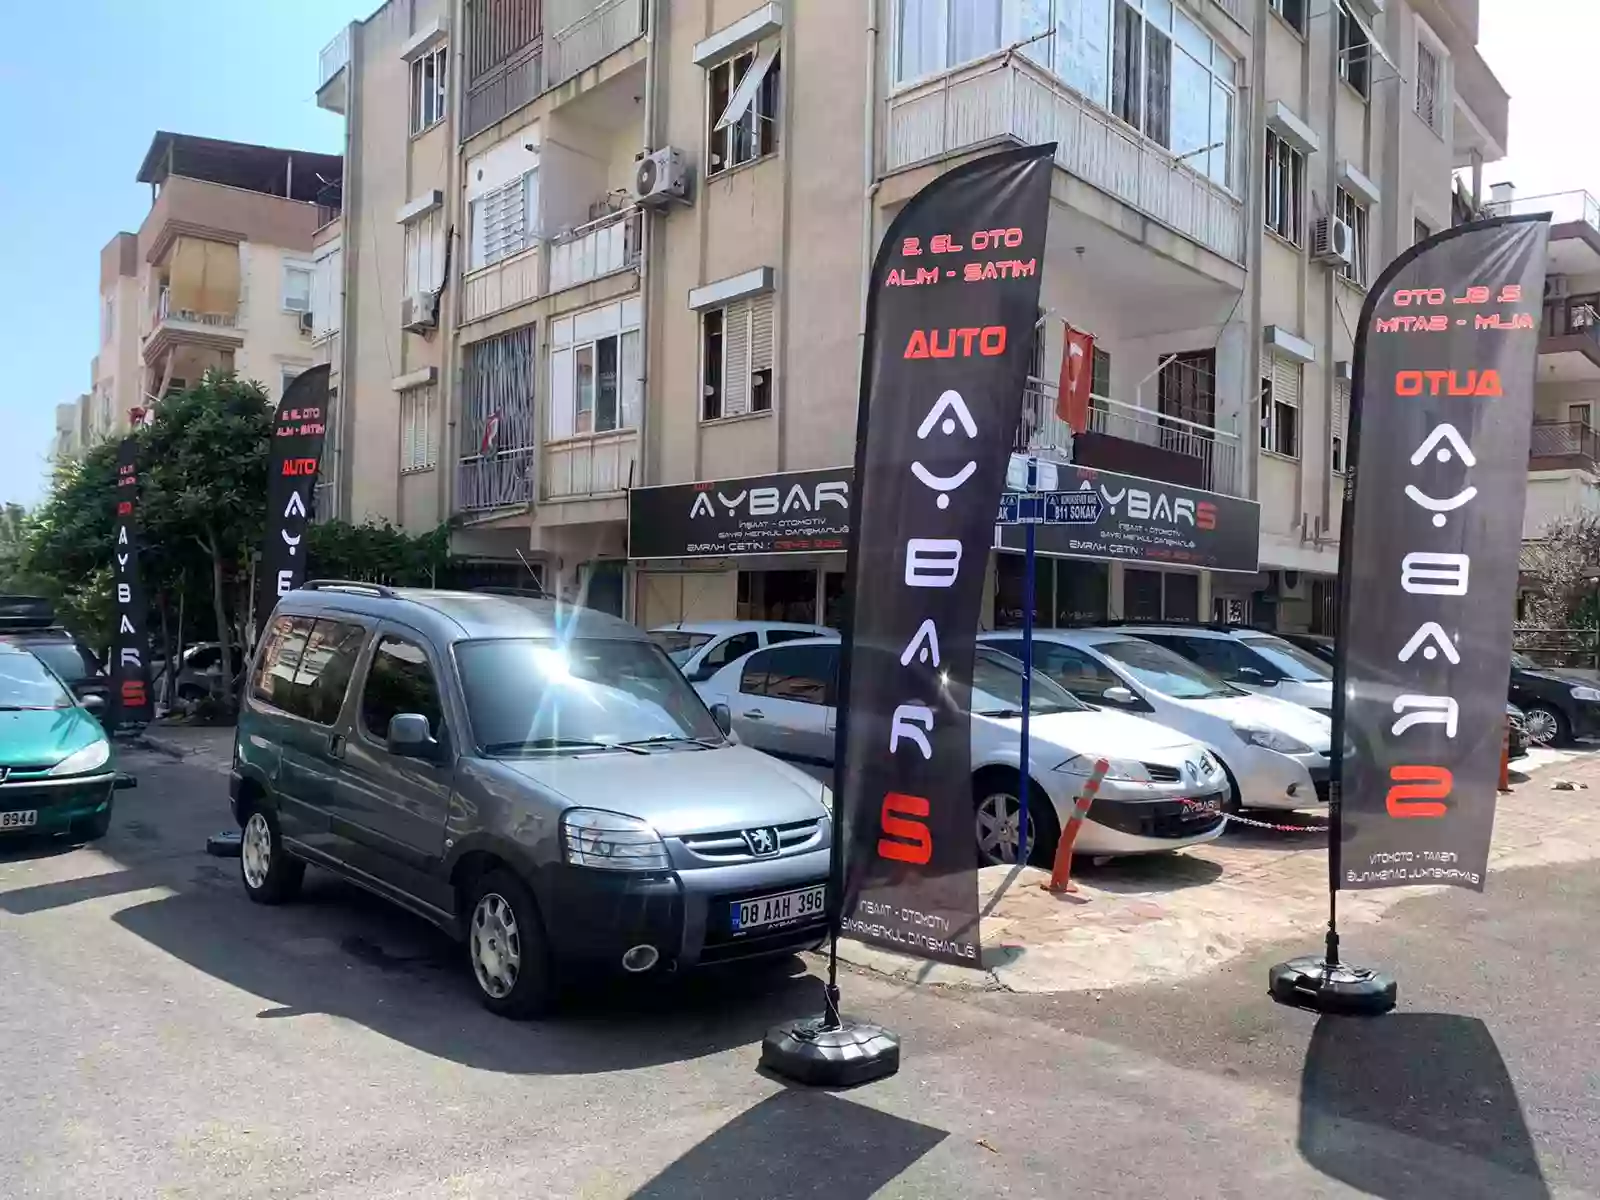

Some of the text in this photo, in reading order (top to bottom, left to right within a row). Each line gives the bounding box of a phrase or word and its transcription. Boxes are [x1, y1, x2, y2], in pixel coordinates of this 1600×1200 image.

[902, 228, 1023, 256] 2. EL OTO
[886, 267, 940, 287] ALIM
[964, 258, 1037, 282] SATIM
[903, 326, 1007, 359] AUTO
[281, 458, 317, 476] AUTO
[1070, 505, 1097, 519] SOKAK
[687, 543, 726, 552] EMRAH
[1069, 540, 1107, 552] EMRAH
[118, 526, 147, 707] AYBARS
[878, 389, 978, 865] AYBARS
[741, 891, 823, 925] 08 AAH 396
